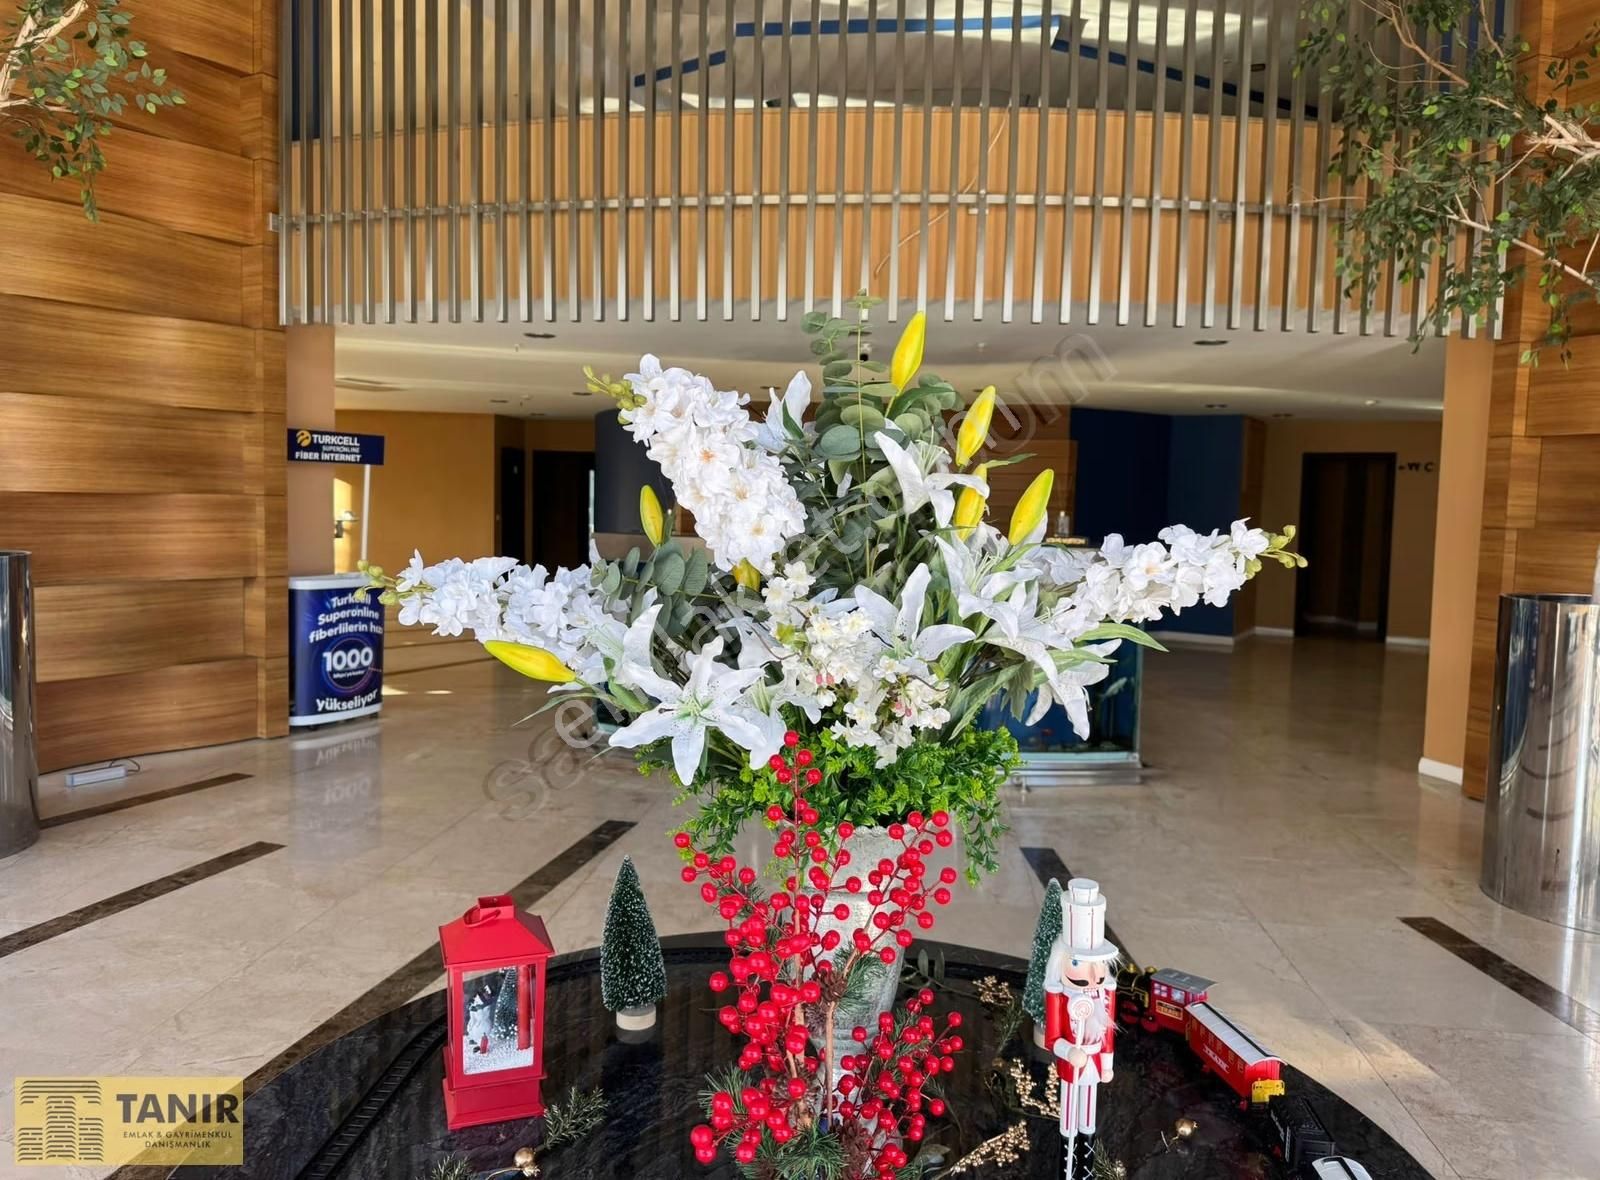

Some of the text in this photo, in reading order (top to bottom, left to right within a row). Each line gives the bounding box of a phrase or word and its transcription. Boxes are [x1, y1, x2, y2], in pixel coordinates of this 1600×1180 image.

[312, 434, 360, 446] TURKCELL
[295, 450, 362, 462] FİBER İNTERNET
[330, 592, 371, 609] Turkll
[317, 606, 380, 626] Superonline
[308, 622, 368, 643] fiberlilerin
[322, 646, 374, 672] 1000
[316, 688, 378, 712] yükseliyor
